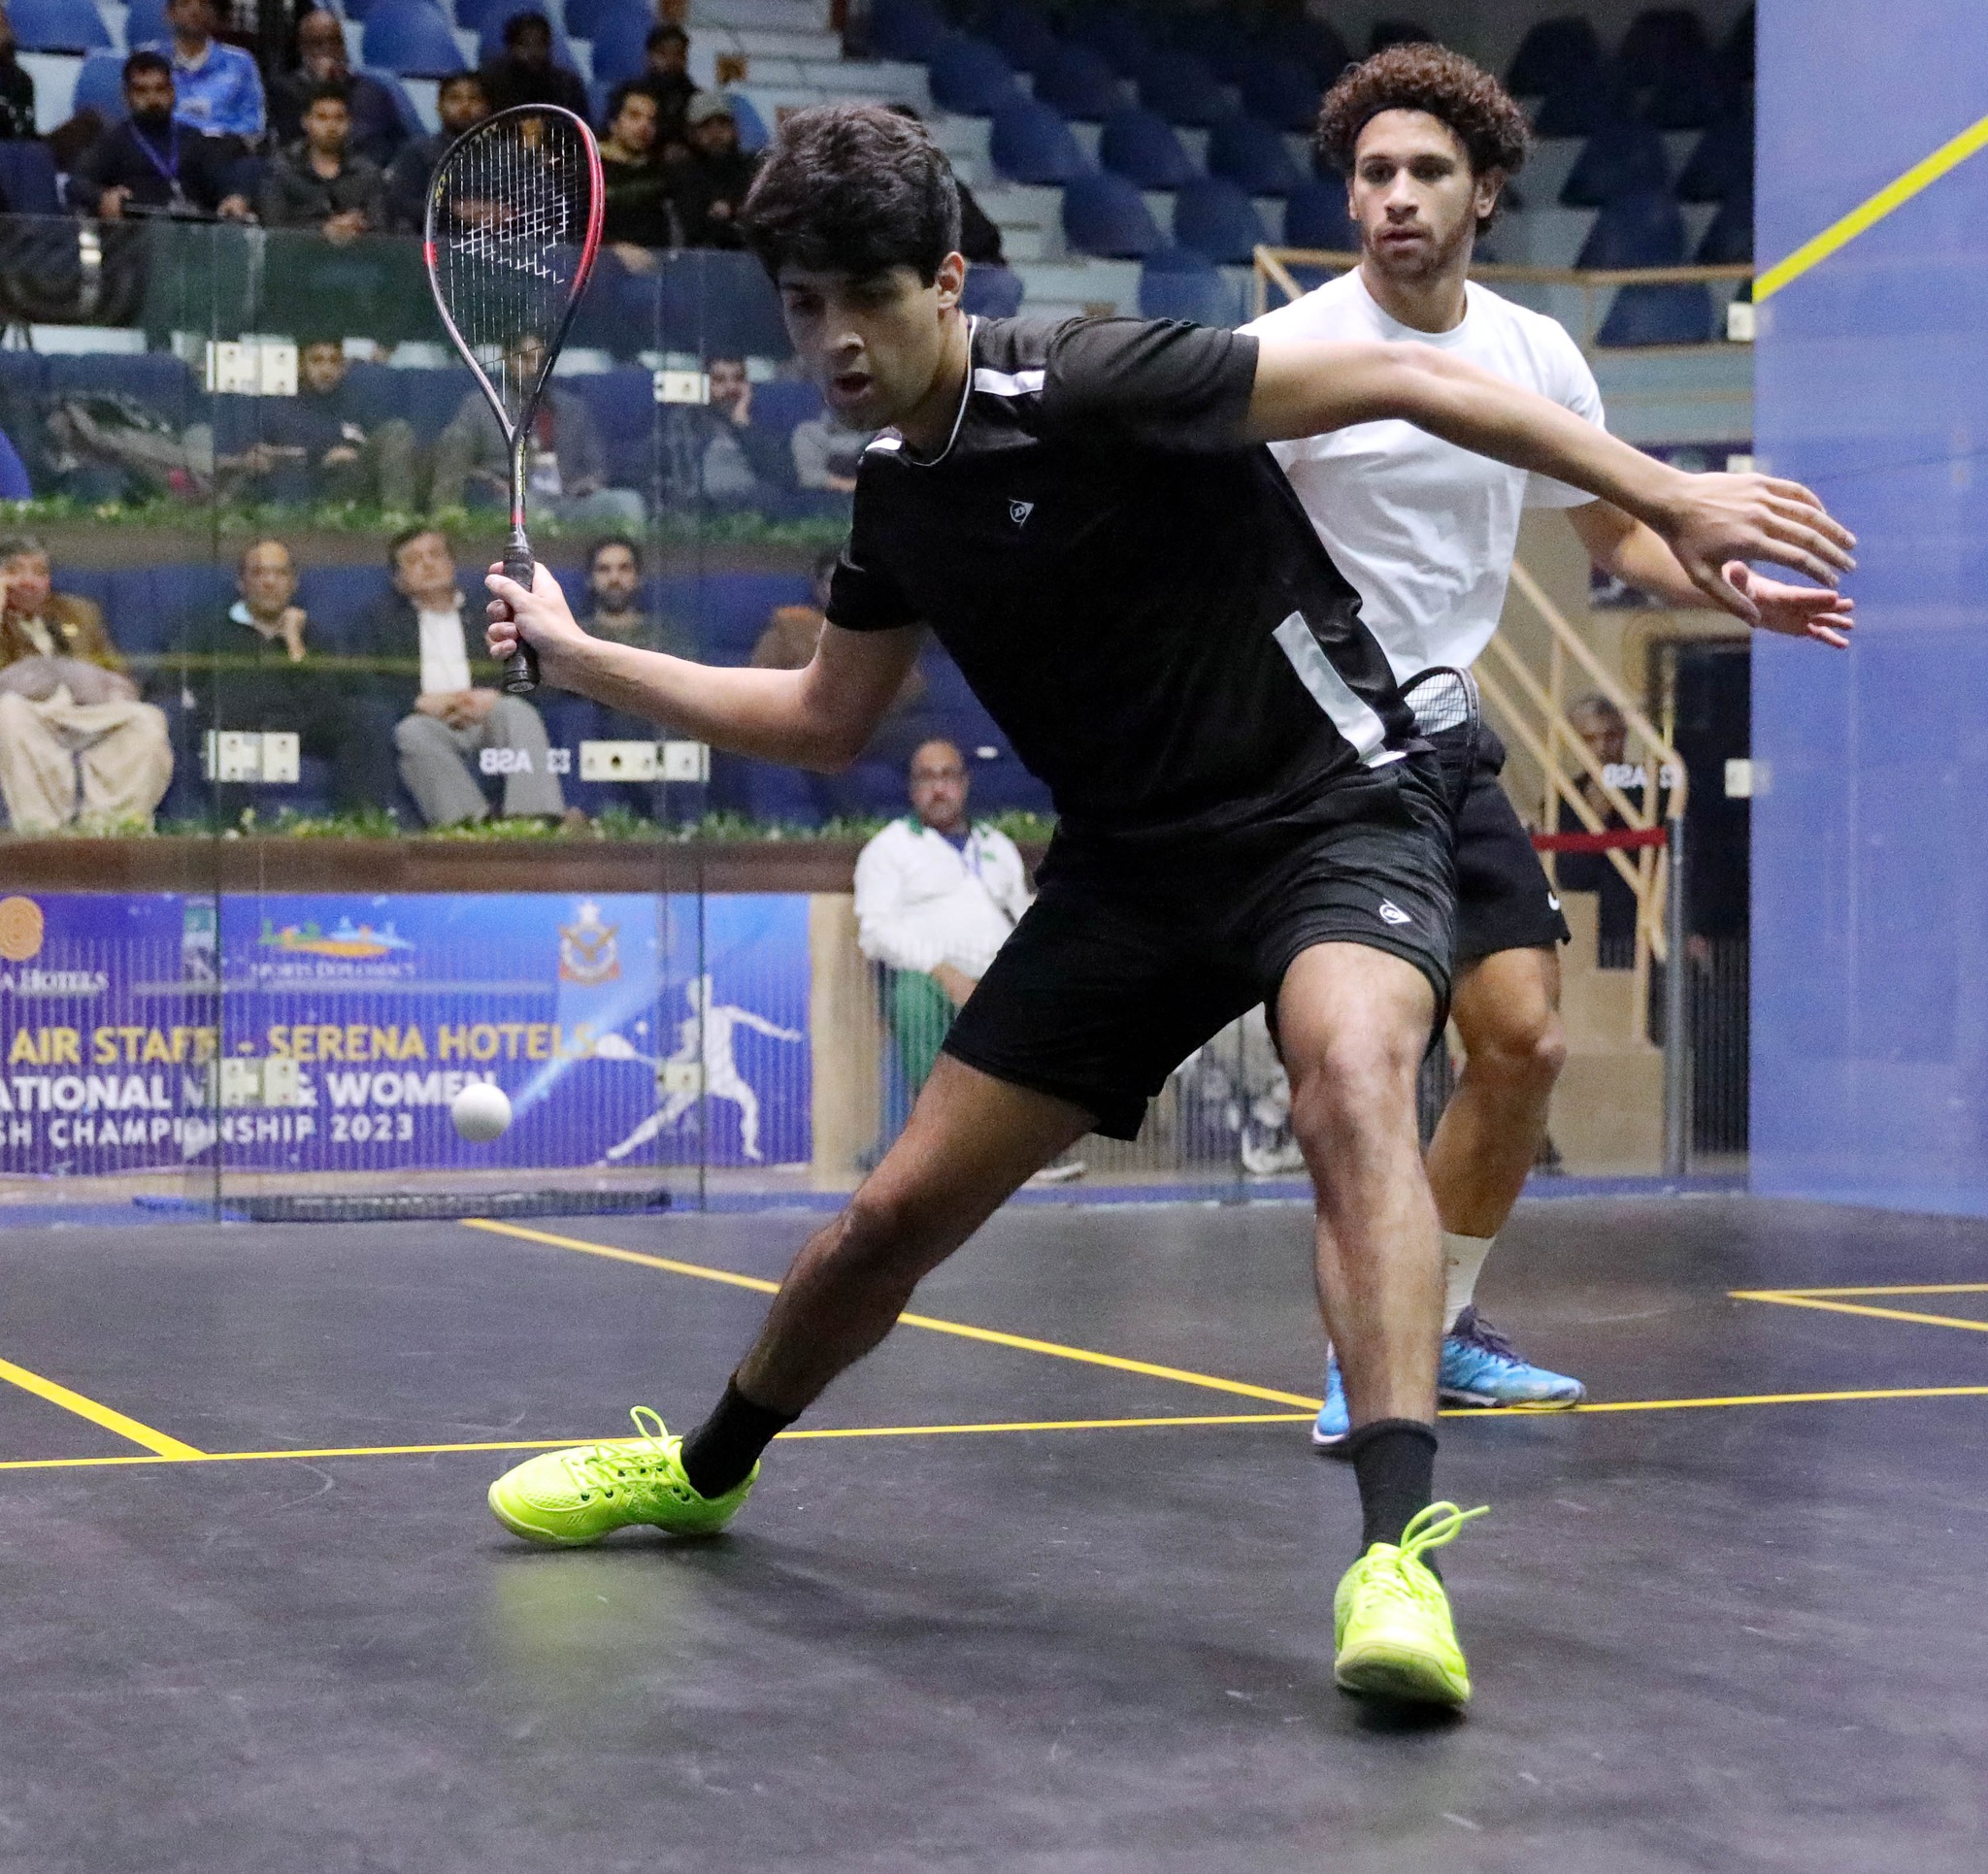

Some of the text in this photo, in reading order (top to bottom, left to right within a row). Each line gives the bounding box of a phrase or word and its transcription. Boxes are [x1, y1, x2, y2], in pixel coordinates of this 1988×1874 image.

[8, 1027, 82, 1065] AIR
[94, 1026, 218, 1064] STAFF
[267, 1025, 427, 1062] SERENA
[438, 1023, 597, 1061] HOTELS
[49, 1115, 315, 1148] CHAMPIONSHIP
[331, 1114, 414, 1143] 2023
